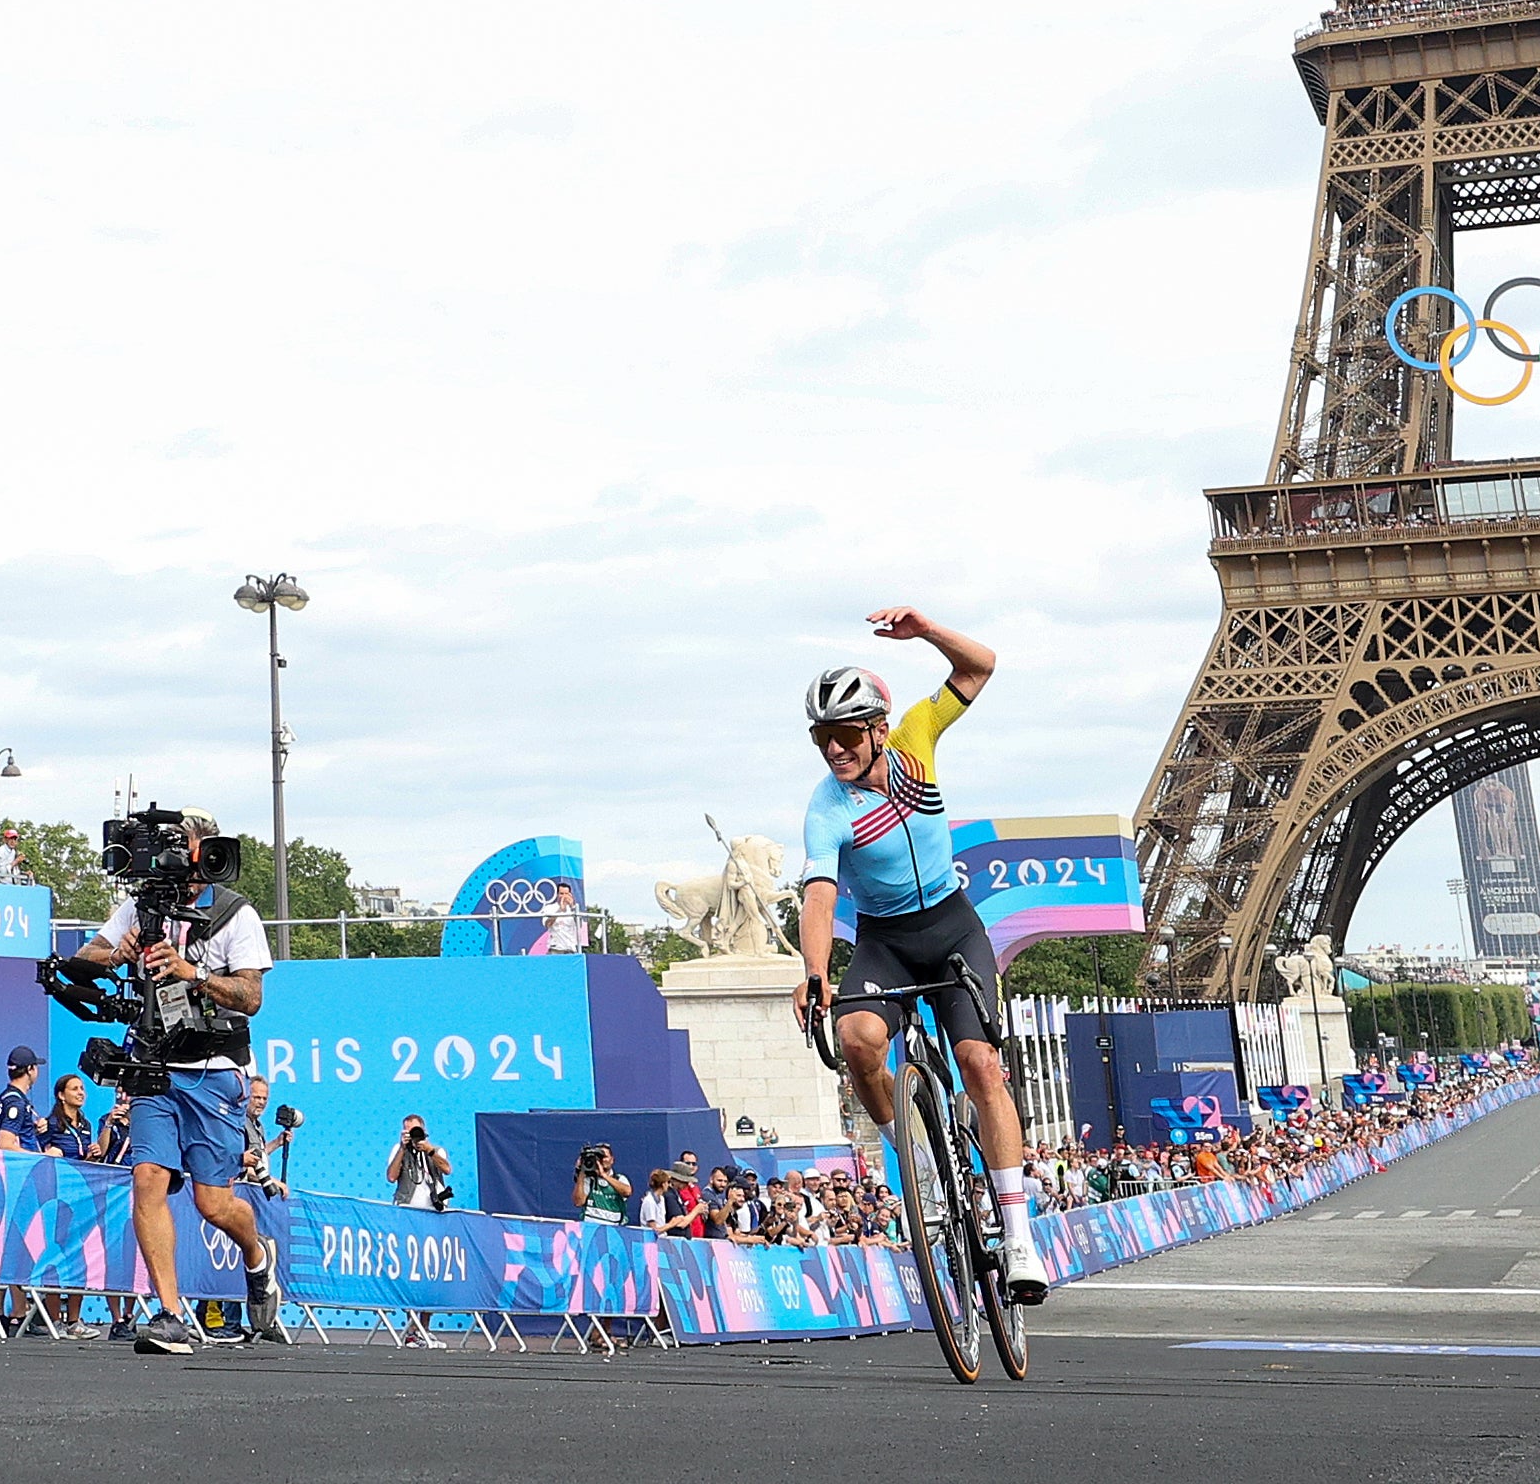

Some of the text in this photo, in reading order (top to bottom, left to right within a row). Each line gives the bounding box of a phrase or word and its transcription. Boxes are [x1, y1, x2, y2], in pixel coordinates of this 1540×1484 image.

[988, 856, 1107, 888] 2024
[392, 1034, 563, 1082] 2024
[1194, 1131, 1214, 1141] 25m
[406, 1234, 468, 1283] 2024
[736, 1288, 765, 1314] 2024
